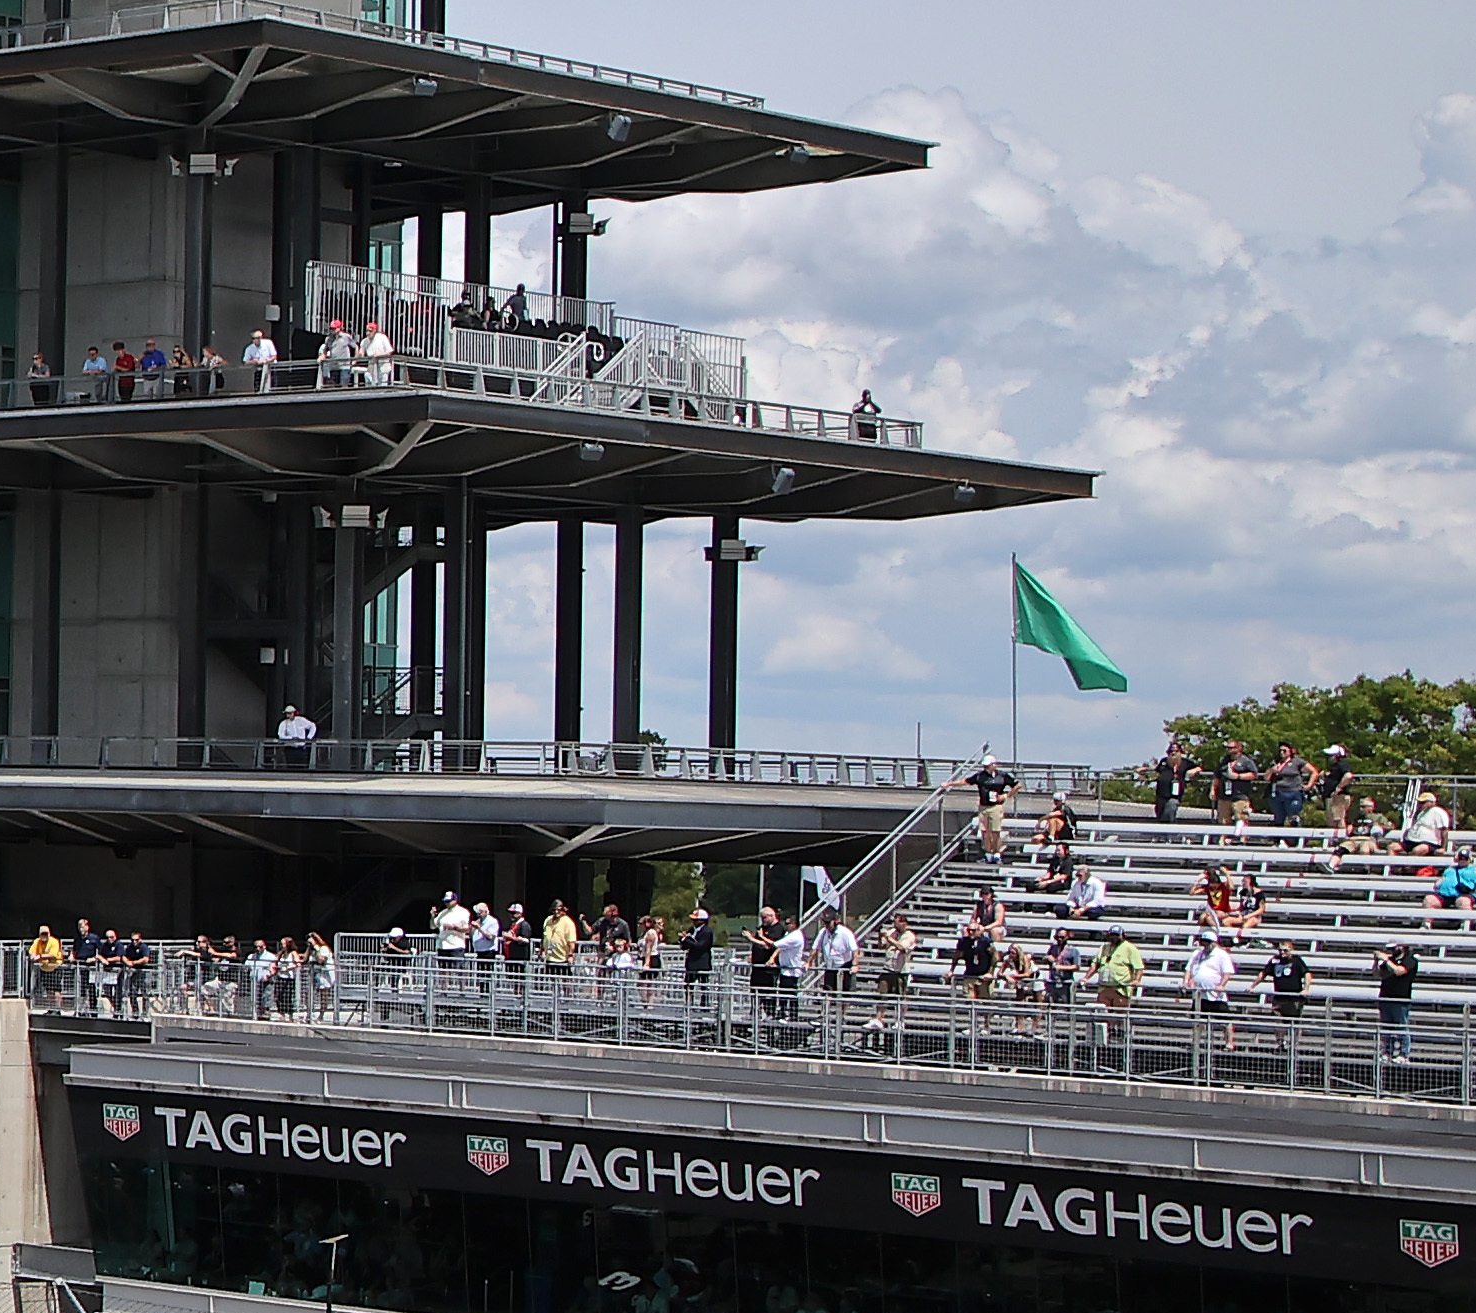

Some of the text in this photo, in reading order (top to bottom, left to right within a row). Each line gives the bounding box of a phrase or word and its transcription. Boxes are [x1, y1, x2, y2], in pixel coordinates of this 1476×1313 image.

[104, 1105, 138, 1120] TAG
[105, 1118, 140, 1139] HEUER
[468, 1137, 508, 1154] TAG
[469, 1152, 509, 1175] HEUER
[893, 1175, 940, 1193] TAG
[894, 1191, 941, 1215] HEUER
[1402, 1220, 1458, 1242] TAG
[1403, 1239, 1459, 1266] HEUER
